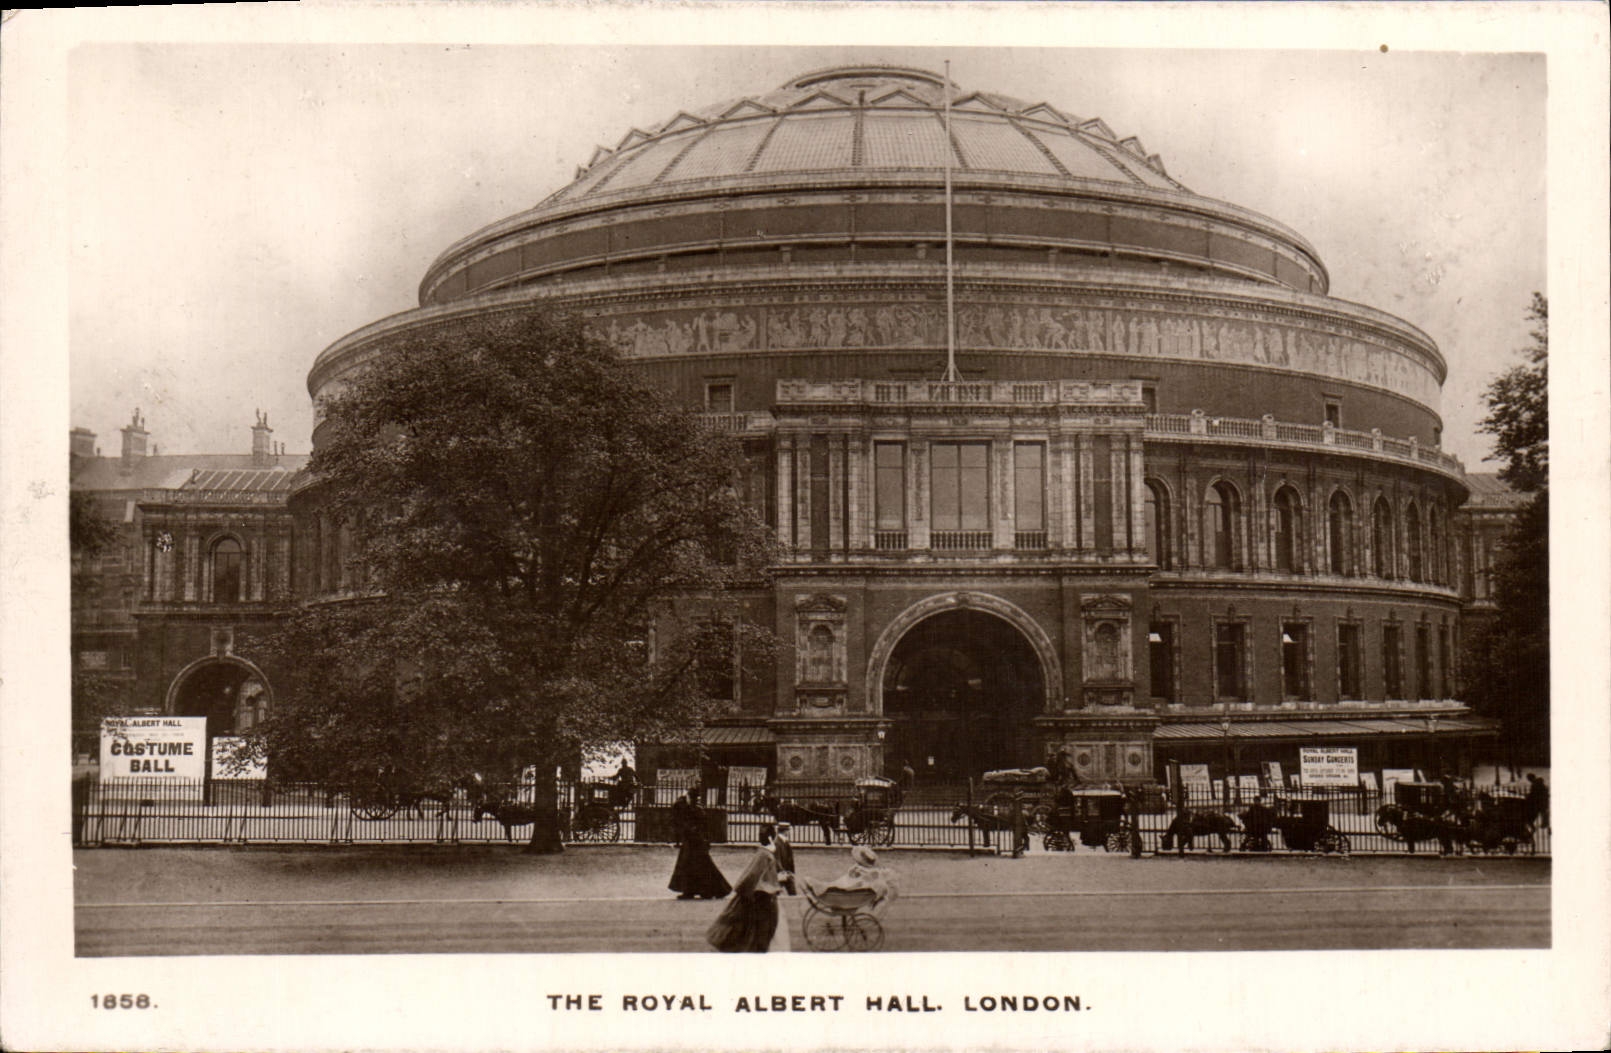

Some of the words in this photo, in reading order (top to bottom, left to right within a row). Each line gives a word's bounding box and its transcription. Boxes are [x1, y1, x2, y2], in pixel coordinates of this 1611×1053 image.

[132, 719, 161, 728] ALBERT
[163, 719, 183, 728] HALL
[110, 741, 194, 756] COSTUME
[130, 759, 175, 773] BALL
